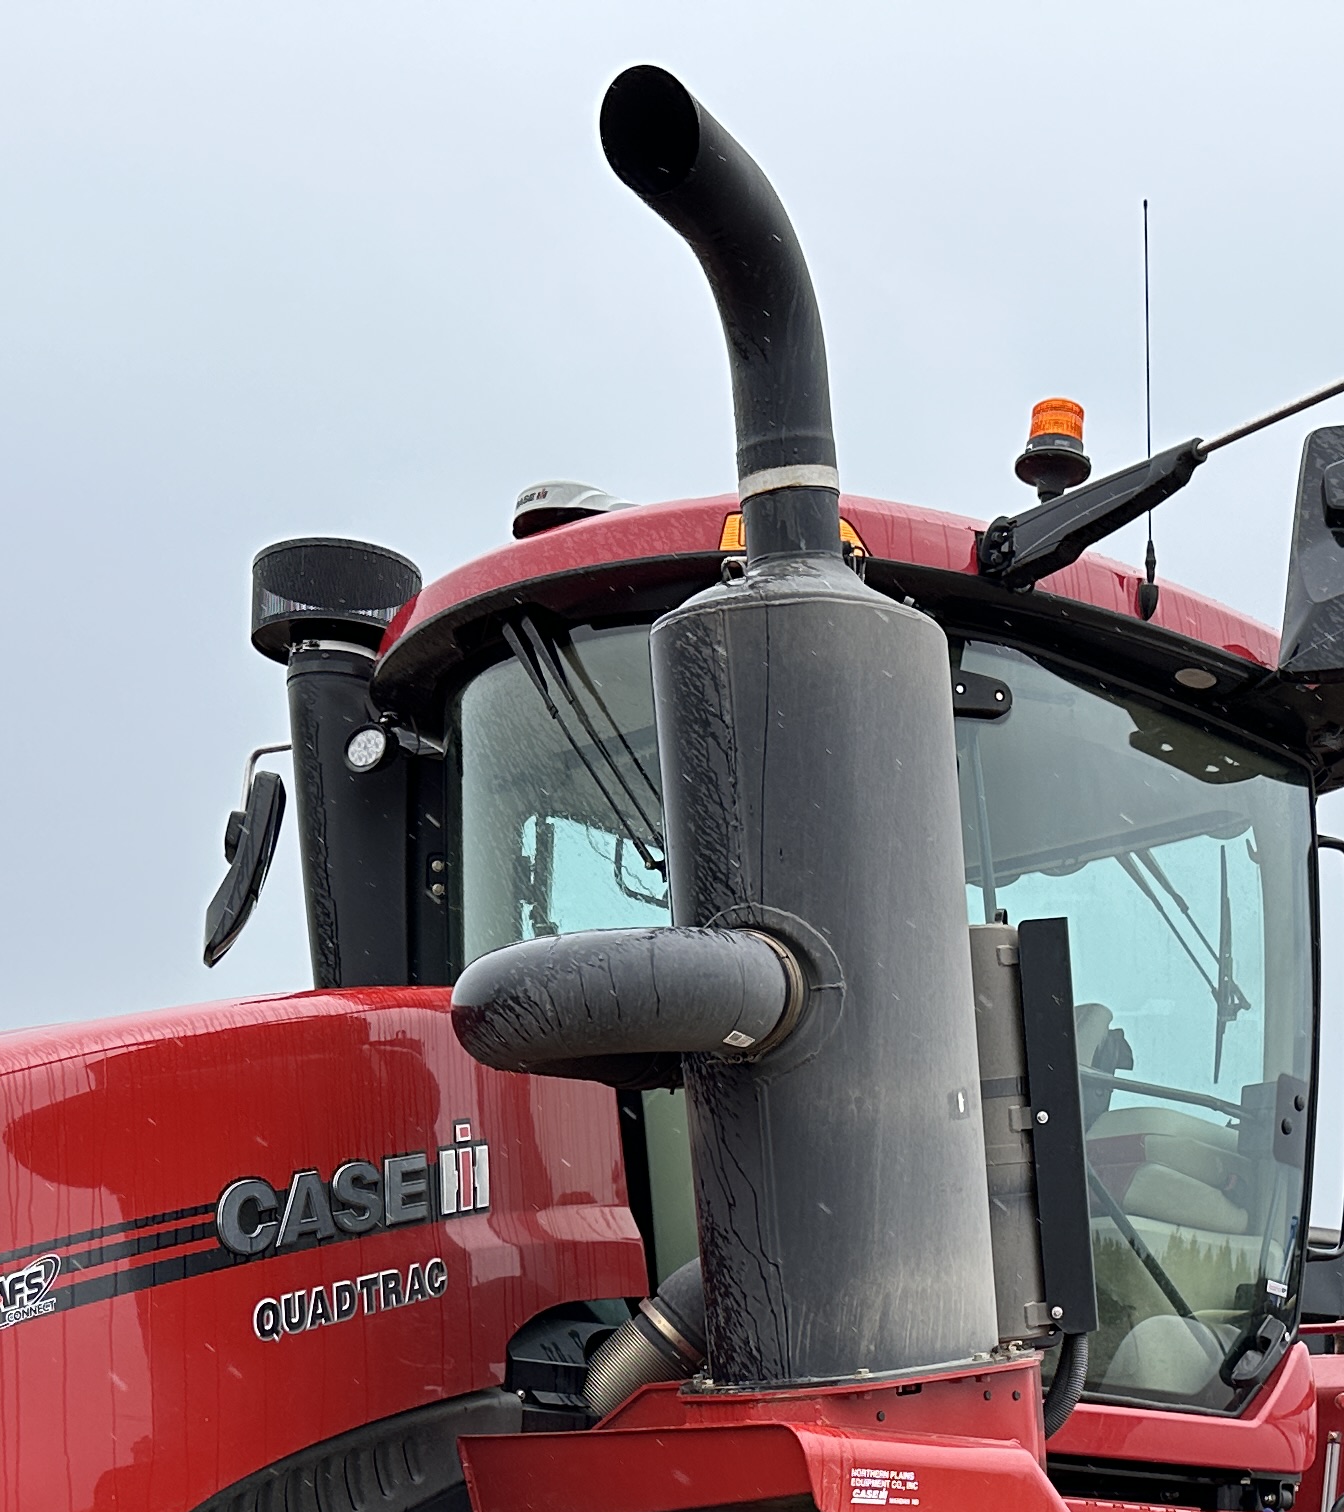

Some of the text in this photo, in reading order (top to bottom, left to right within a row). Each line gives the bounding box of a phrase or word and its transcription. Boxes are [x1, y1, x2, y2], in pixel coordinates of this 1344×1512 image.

[216, 1152, 429, 1255] CASE
[6, 1300, 56, 1323] CONNECT
[253, 1257, 448, 1342] QUADTRAC
[852, 1488, 879, 1499] CASE
